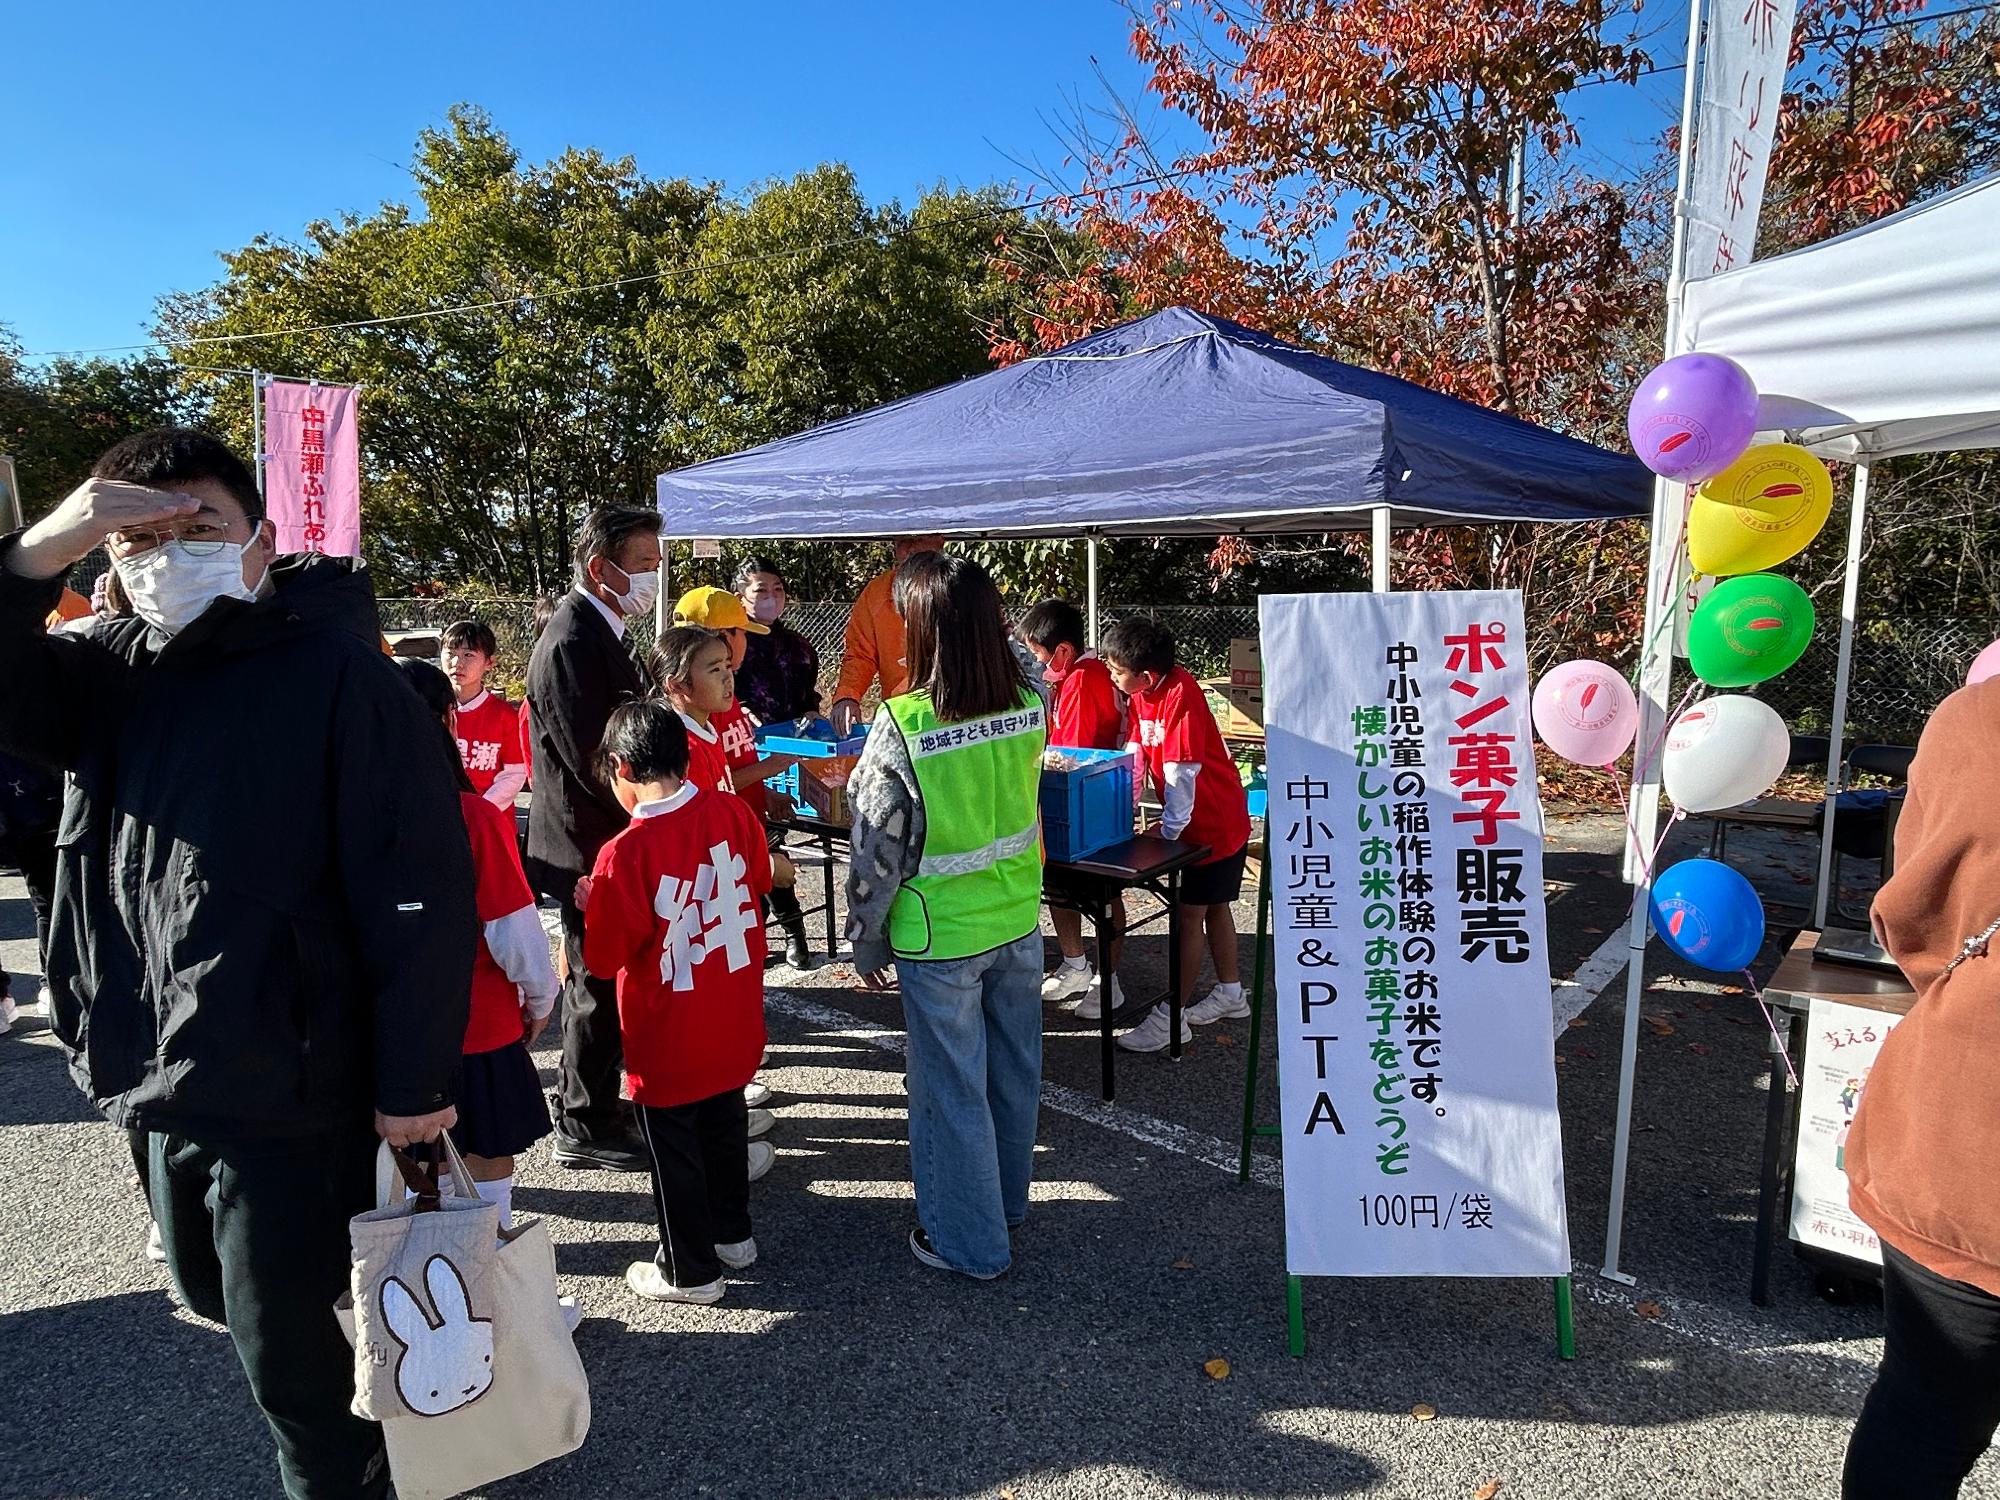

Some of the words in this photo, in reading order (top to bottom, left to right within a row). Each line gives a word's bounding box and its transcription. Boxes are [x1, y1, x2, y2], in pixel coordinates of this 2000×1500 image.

[920, 711, 1039, 752] 地域子ども見守り隊
[1443, 621, 1530, 964] ポン菓子販売
[654, 840, 758, 992] 絆
[1351, 705, 1409, 1176] 懐かしいお米のお菓子をどうぞ
[1386, 641, 1446, 1118] 中小児童の稲作体験のお米です。
[1822, 1025, 1892, 1052] 支える
[1359, 1192, 1493, 1230] 100円/袋
